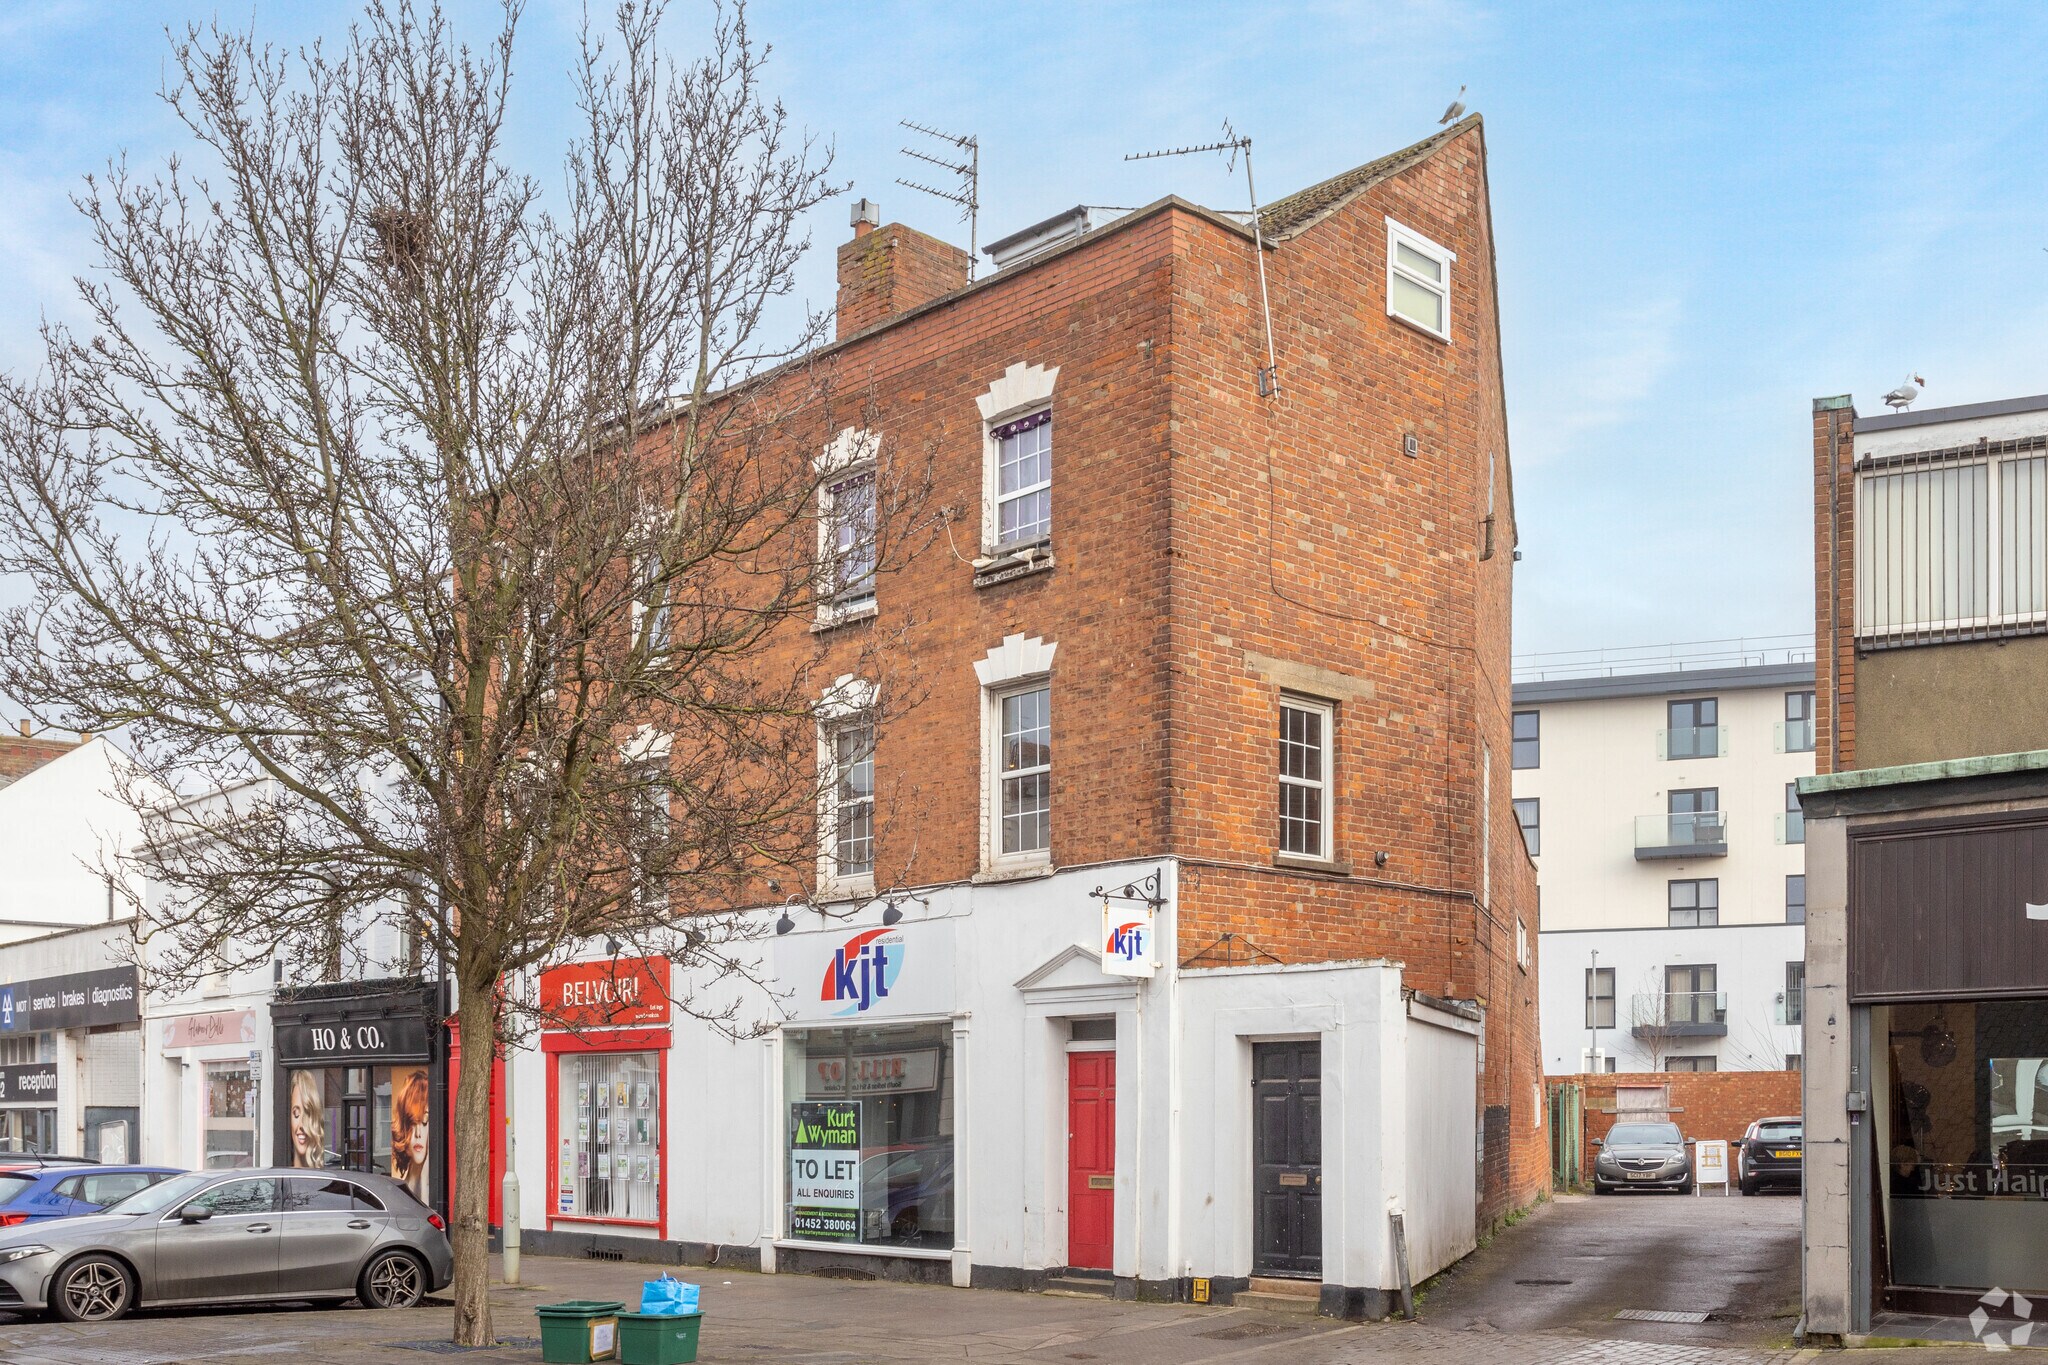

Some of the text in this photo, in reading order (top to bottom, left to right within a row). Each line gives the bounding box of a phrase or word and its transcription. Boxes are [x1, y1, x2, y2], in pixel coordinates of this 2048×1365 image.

[875, 934, 904, 945] residential
[1114, 928, 1142, 961] kjt
[835, 945, 889, 1011] kjt
[16, 983, 133, 1013] MOT service brakes diagnostics
[311, 1026, 385, 1051] HO & CO.
[18, 1069, 57, 1094] reception
[827, 1109, 855, 1127] Kurt
[807, 1125, 856, 1147] Wyman
[795, 1159, 856, 1180] TO LET
[1918, 1168, 1978, 1192] Just
[797, 1188, 855, 1199] ALL ENQUIRIES
[795, 1217, 856, 1231] 01452 380064
[1195, 1280, 1207, 1300] H
